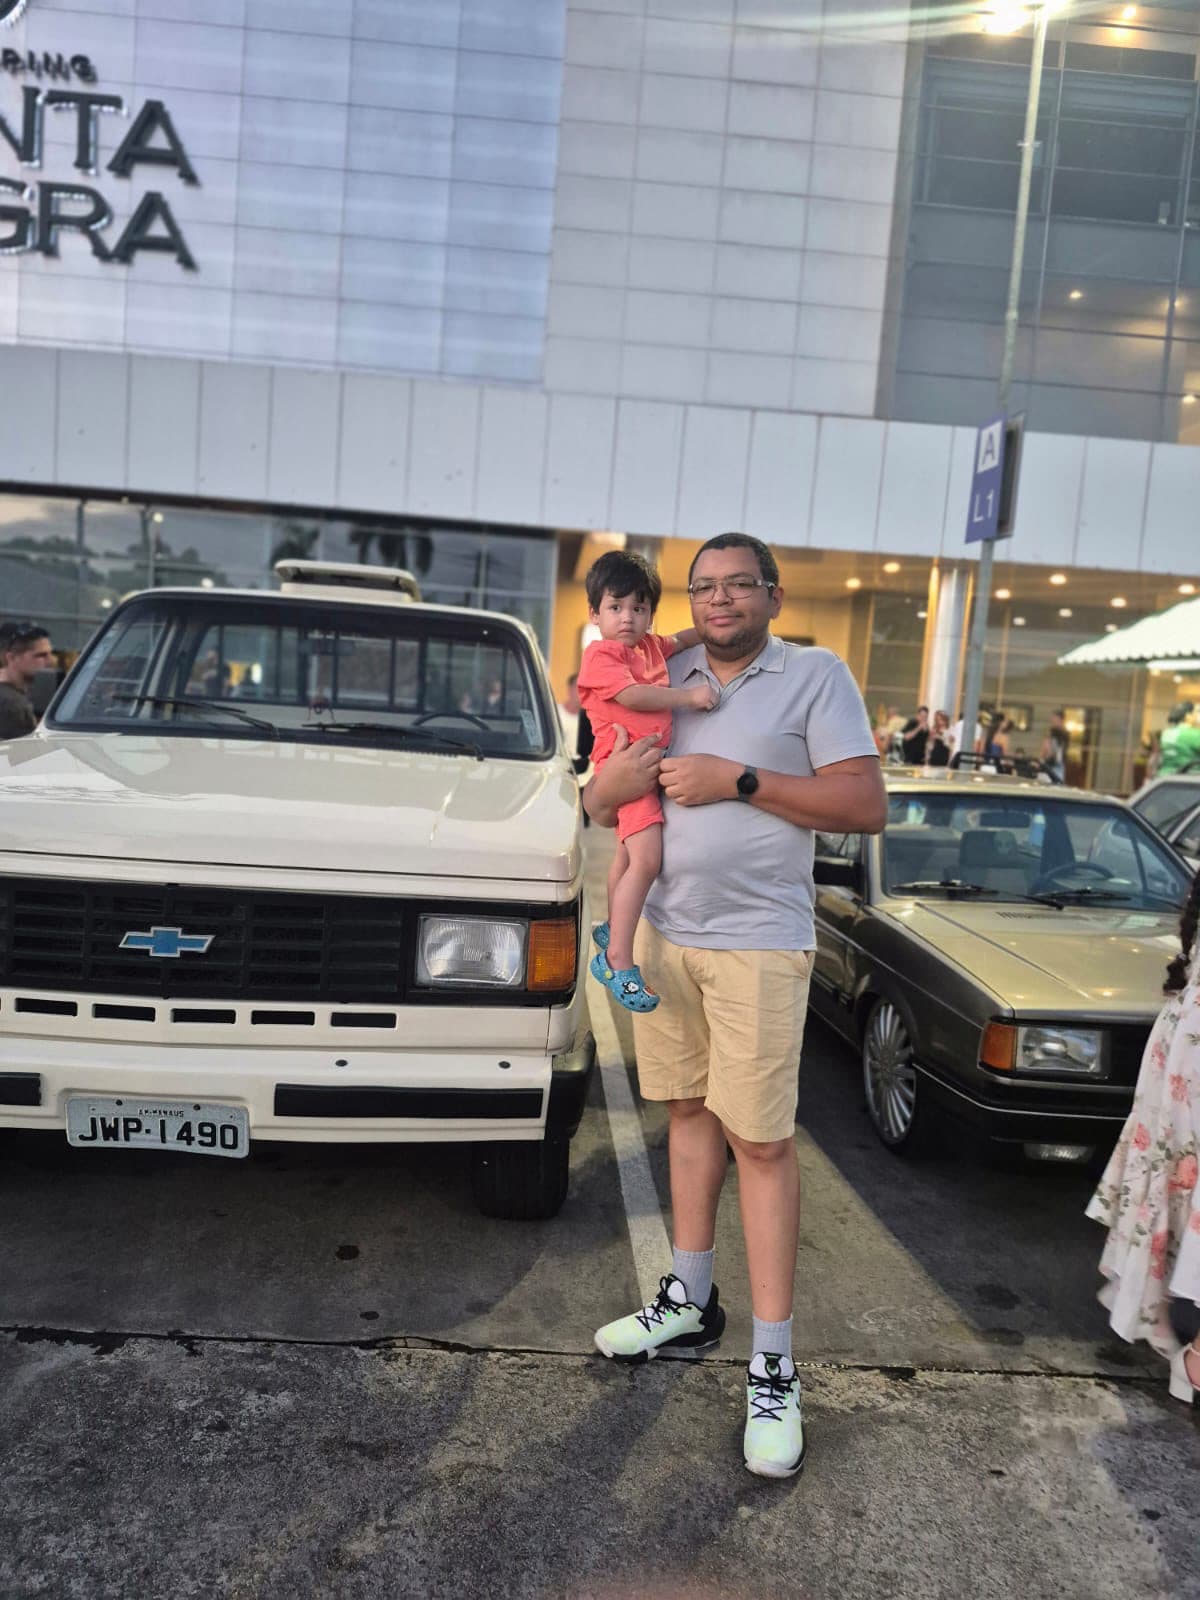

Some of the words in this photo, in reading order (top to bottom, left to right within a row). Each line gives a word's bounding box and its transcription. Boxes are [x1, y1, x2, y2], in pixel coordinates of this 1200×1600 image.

[0, 85, 201, 187] NTA
[981, 431, 996, 466] A
[973, 489, 995, 522] L1
